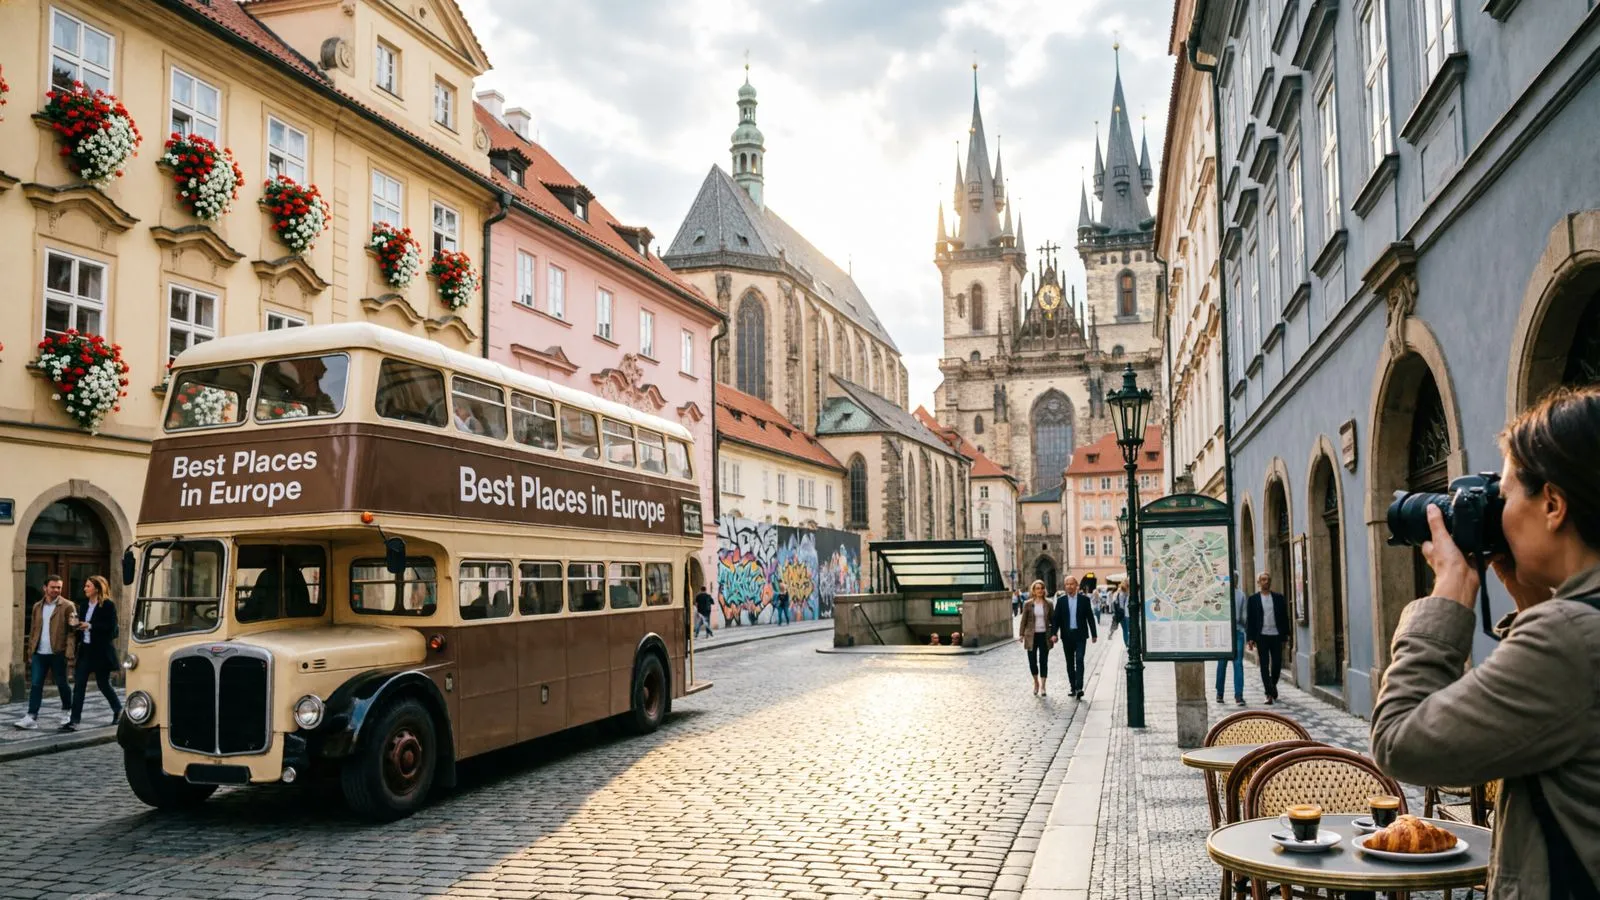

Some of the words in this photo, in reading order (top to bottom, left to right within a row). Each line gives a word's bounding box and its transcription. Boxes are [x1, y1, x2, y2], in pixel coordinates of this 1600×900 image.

[172, 454, 226, 478] Best
[232, 450, 318, 475] Places
[180, 482, 202, 507] in
[209, 480, 302, 508] Europe
[459, 465, 515, 507] Best
[521, 475, 587, 515] Places
[591, 485, 607, 516] in
[611, 489, 666, 528] Europe
